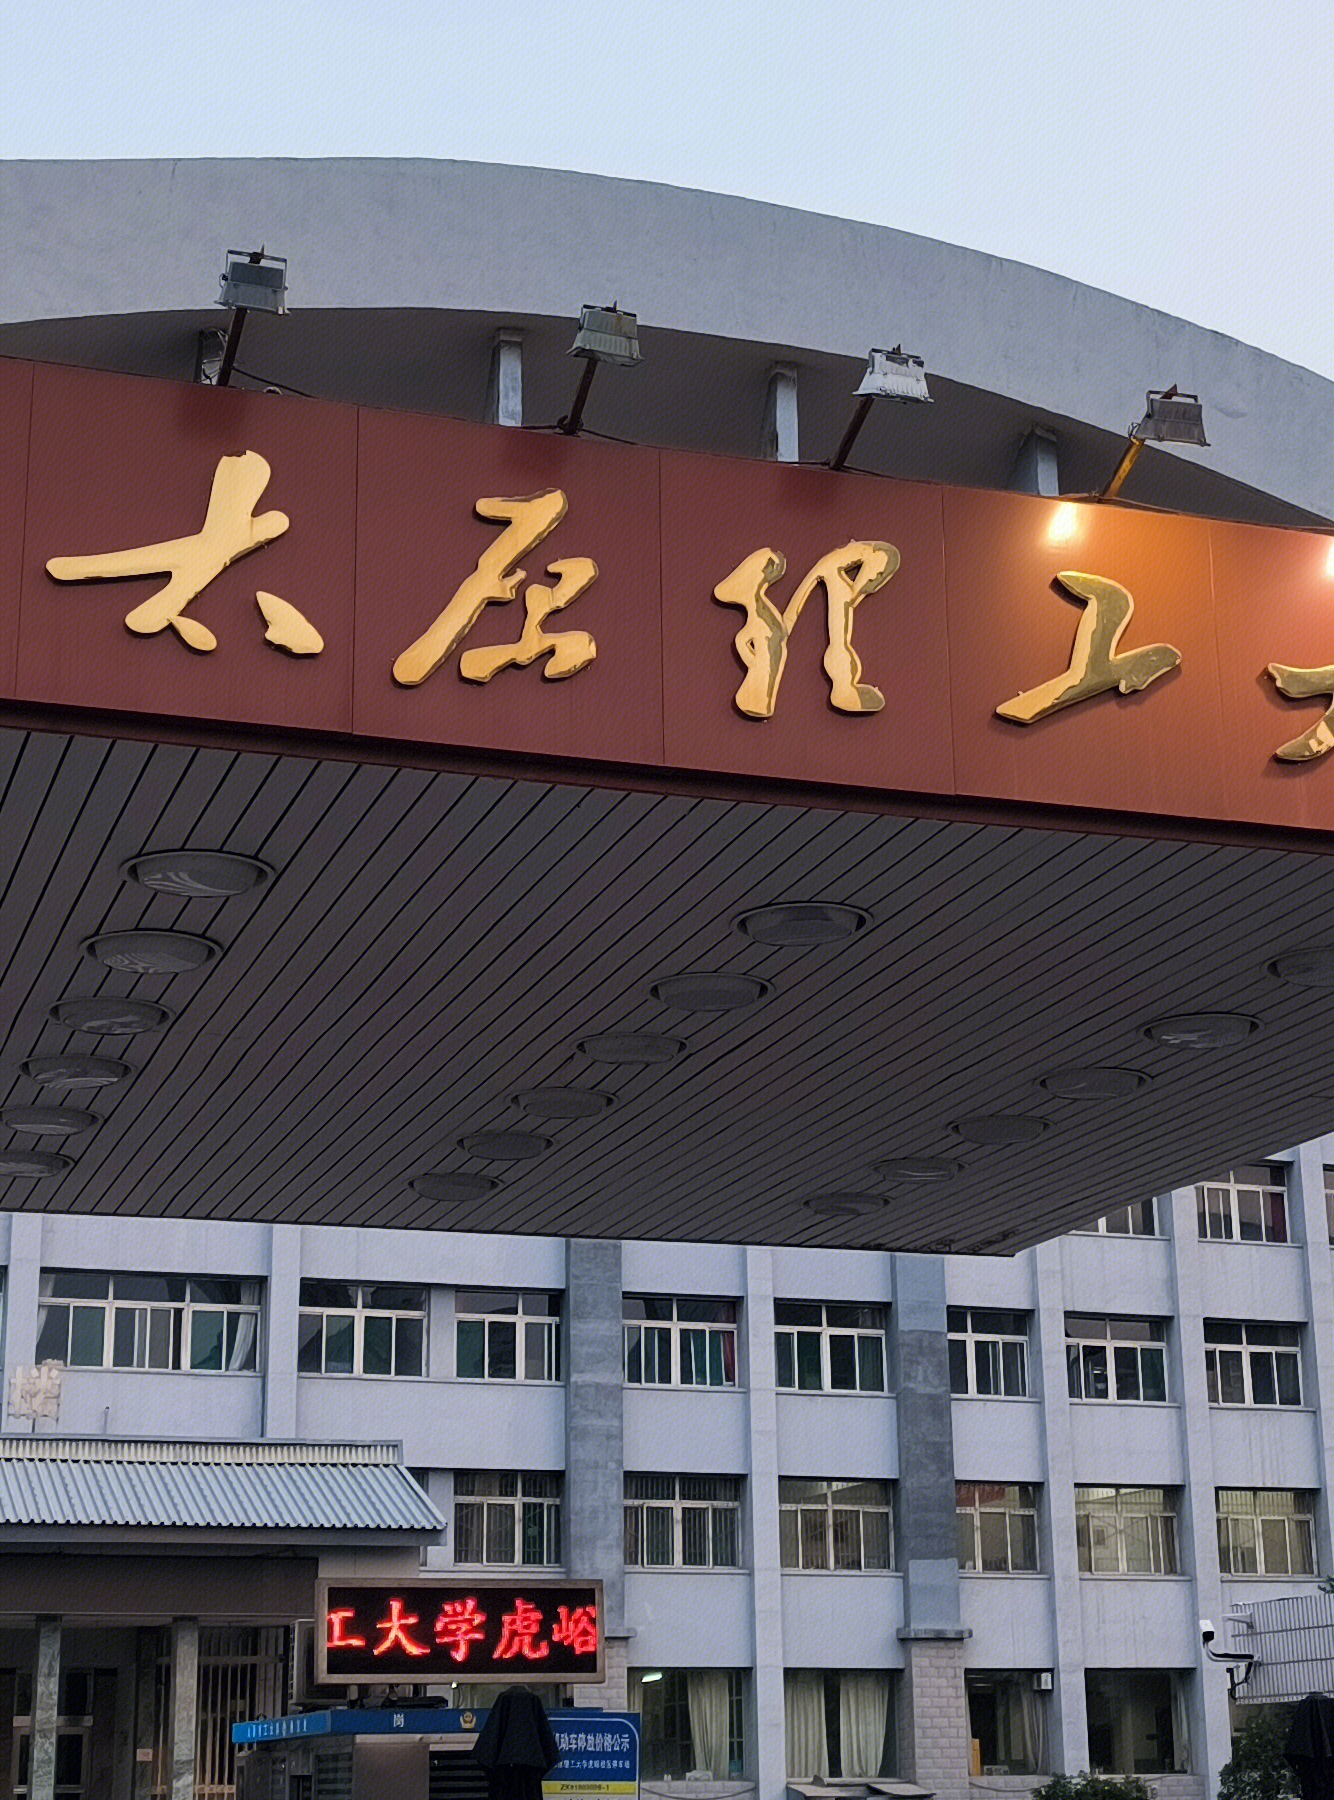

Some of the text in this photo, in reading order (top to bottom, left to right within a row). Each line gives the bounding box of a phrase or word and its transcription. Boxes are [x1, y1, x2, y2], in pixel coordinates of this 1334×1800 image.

[327, 1597, 596, 1662] 工大学虎峪
